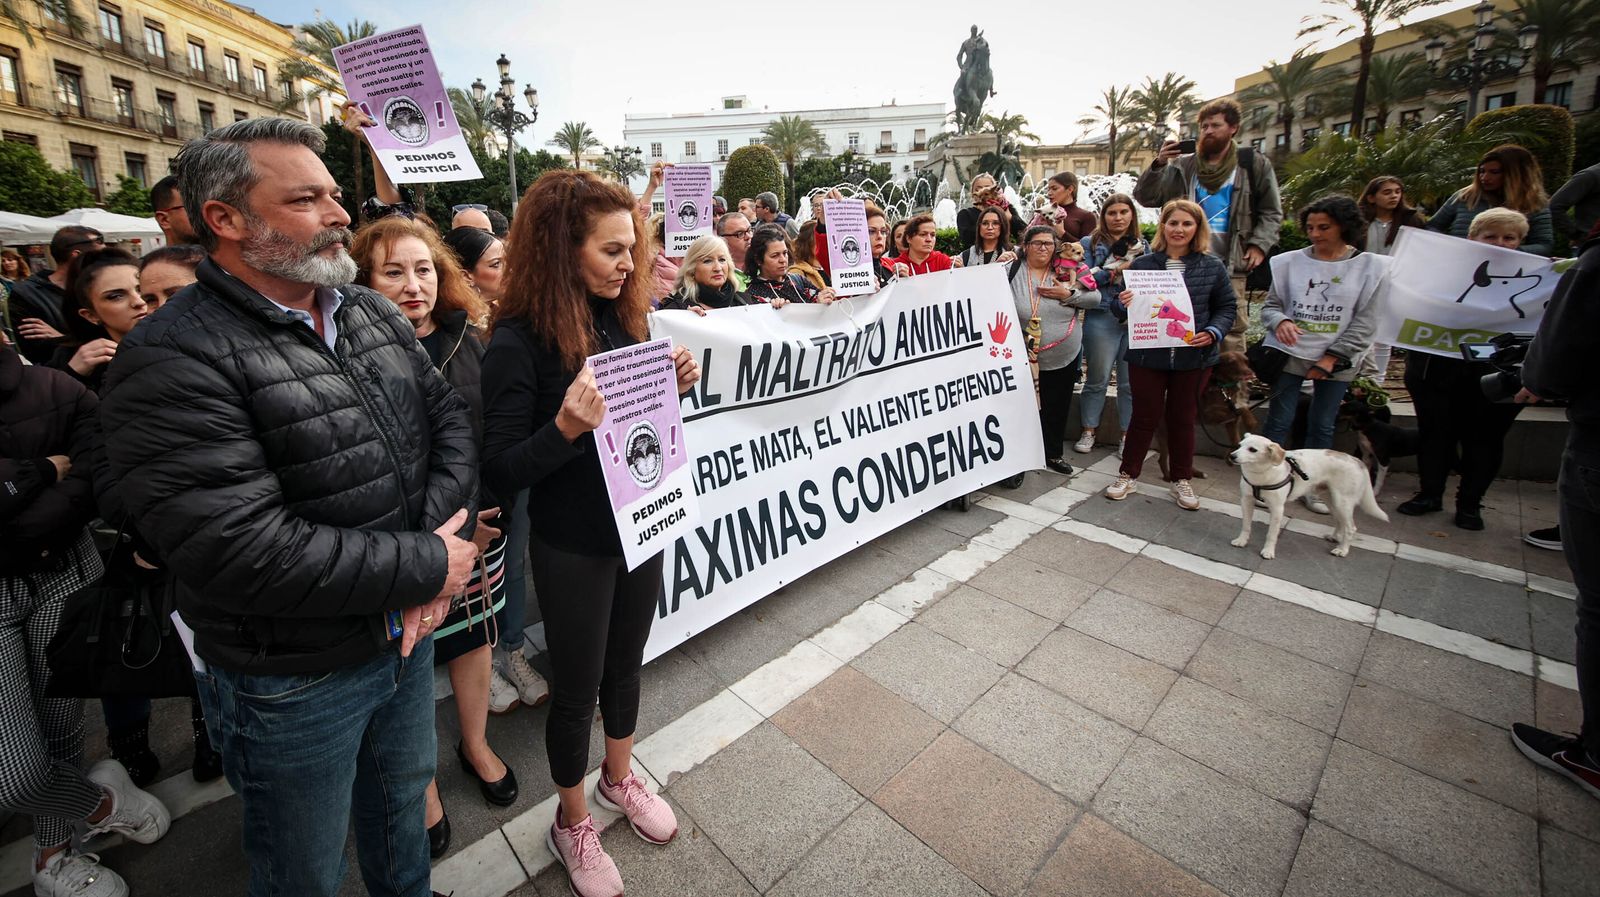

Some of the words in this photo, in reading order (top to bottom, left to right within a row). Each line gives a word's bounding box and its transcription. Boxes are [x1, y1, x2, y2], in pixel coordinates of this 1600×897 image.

[354, 39, 378, 50] familia
[379, 28, 421, 43] destrozada,
[357, 51, 372, 59] niña
[373, 38, 423, 55] traumatizada,
[366, 59, 380, 67] vivo
[381, 50, 418, 63] asesinado
[419, 47, 429, 55] de
[355, 70, 377, 80] forma
[377, 63, 407, 74] violenta
[361, 77, 390, 88] asesino
[390, 73, 414, 82] suelto
[367, 86, 399, 97] nuestras
[400, 80, 425, 90] calles.
[395, 151, 456, 162] PEDIMOS
[401, 163, 462, 174] JUSTICIA
[839, 271, 869, 279] PEDIMOS
[840, 280, 870, 289] JUSTICIA
[1413, 326, 1494, 349] PAC
[593, 358, 608, 367] Una
[608, 351, 633, 364] familia
[633, 341, 671, 356] destrozada,
[735, 315, 886, 402] MALTRATO
[894, 298, 982, 361] ANIMAL
[595, 370, 609, 380] una
[610, 365, 625, 375] niña
[626, 353, 671, 371] traumatizada,
[604, 381, 615, 390] ser
[617, 376, 631, 386] vivo
[632, 367, 665, 381] asesinado
[665, 363, 673, 372] de
[604, 389, 625, 402] forma
[626, 382, 653, 395] violenta
[654, 379, 658, 388] y
[659, 377, 667, 385] un
[608, 399, 635, 413] asesino
[636, 392, 657, 404] suelto
[657, 389, 666, 397] en
[612, 409, 642, 425] nuestras
[643, 401, 664, 414] calles.
[691, 443, 747, 497] RDE
[750, 426, 812, 474] MATA,
[814, 415, 841, 450] EL
[842, 387, 933, 440] VALIENTE
[935, 365, 1017, 413] DEFIENDE
[832, 414, 1005, 524] CONDENAS
[632, 488, 683, 525] PEDIMOS
[637, 507, 687, 546] JUSTICIA
